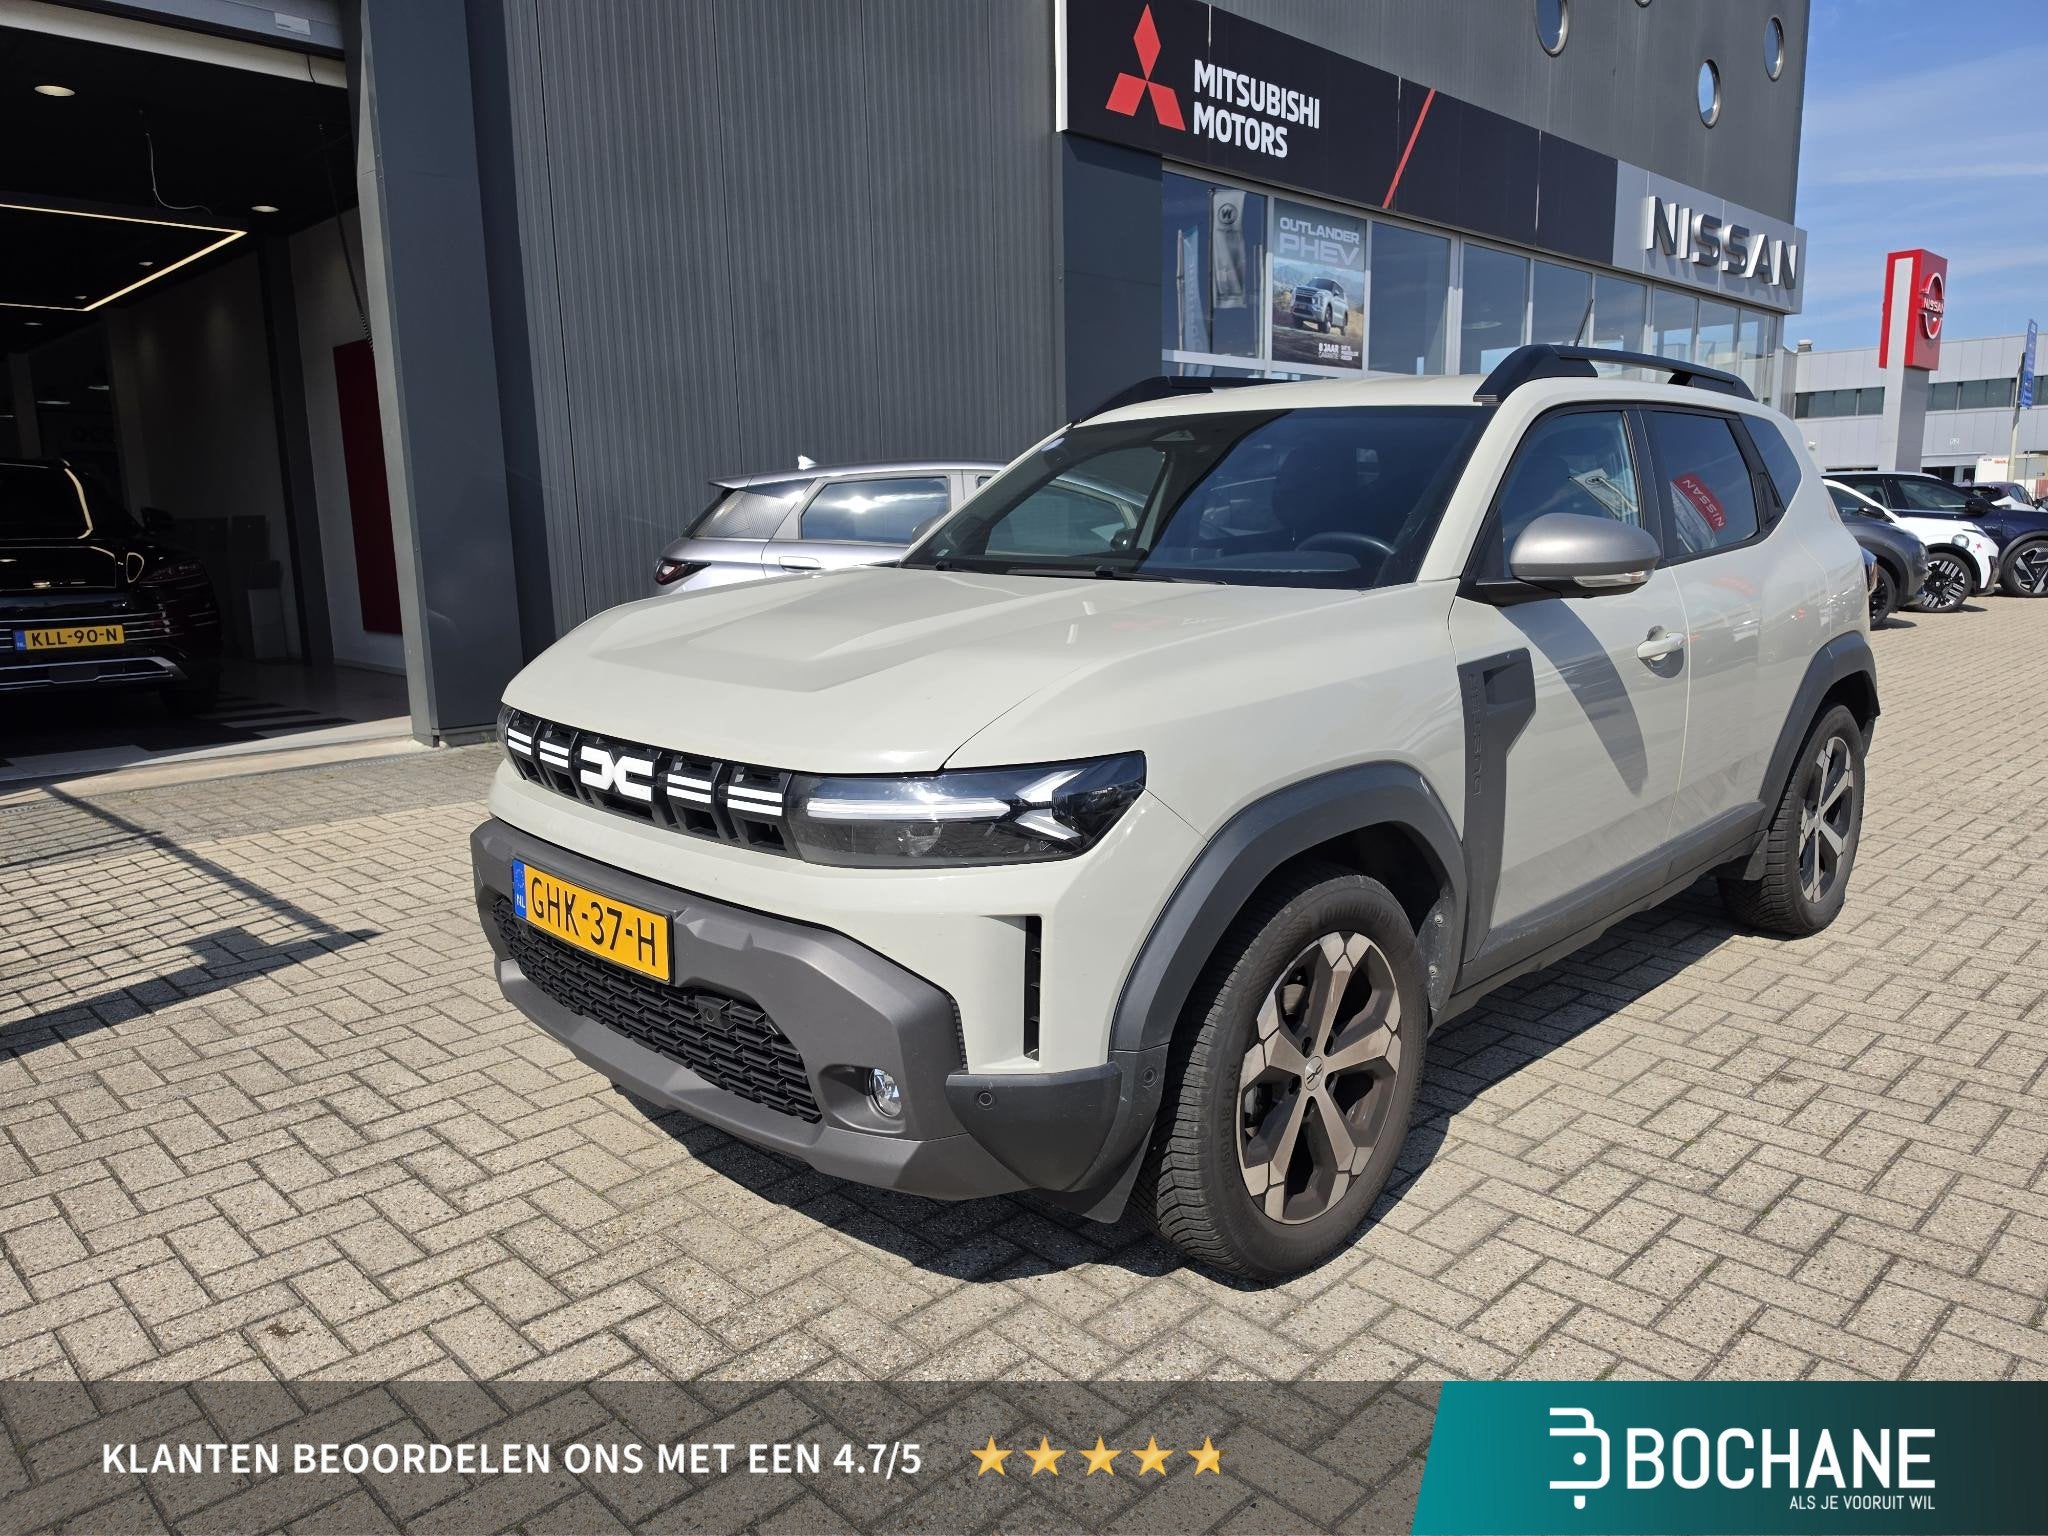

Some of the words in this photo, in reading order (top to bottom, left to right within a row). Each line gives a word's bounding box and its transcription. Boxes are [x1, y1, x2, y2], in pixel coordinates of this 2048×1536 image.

[1194, 59, 1320, 129] MITSUBISHI
[1193, 101, 1288, 158] MOTORS
[1280, 217, 1360, 245] OUTLANDER
[1280, 232, 1360, 265] PHEV
[1646, 196, 1798, 289] NISSAN
[1923, 297, 1944, 314] NISSAN
[1682, 479, 1725, 527] NISSAN
[31, 628, 118, 647] KLL-90-N
[516, 894, 526, 909] NL
[531, 877, 656, 967] GHK-37-H
